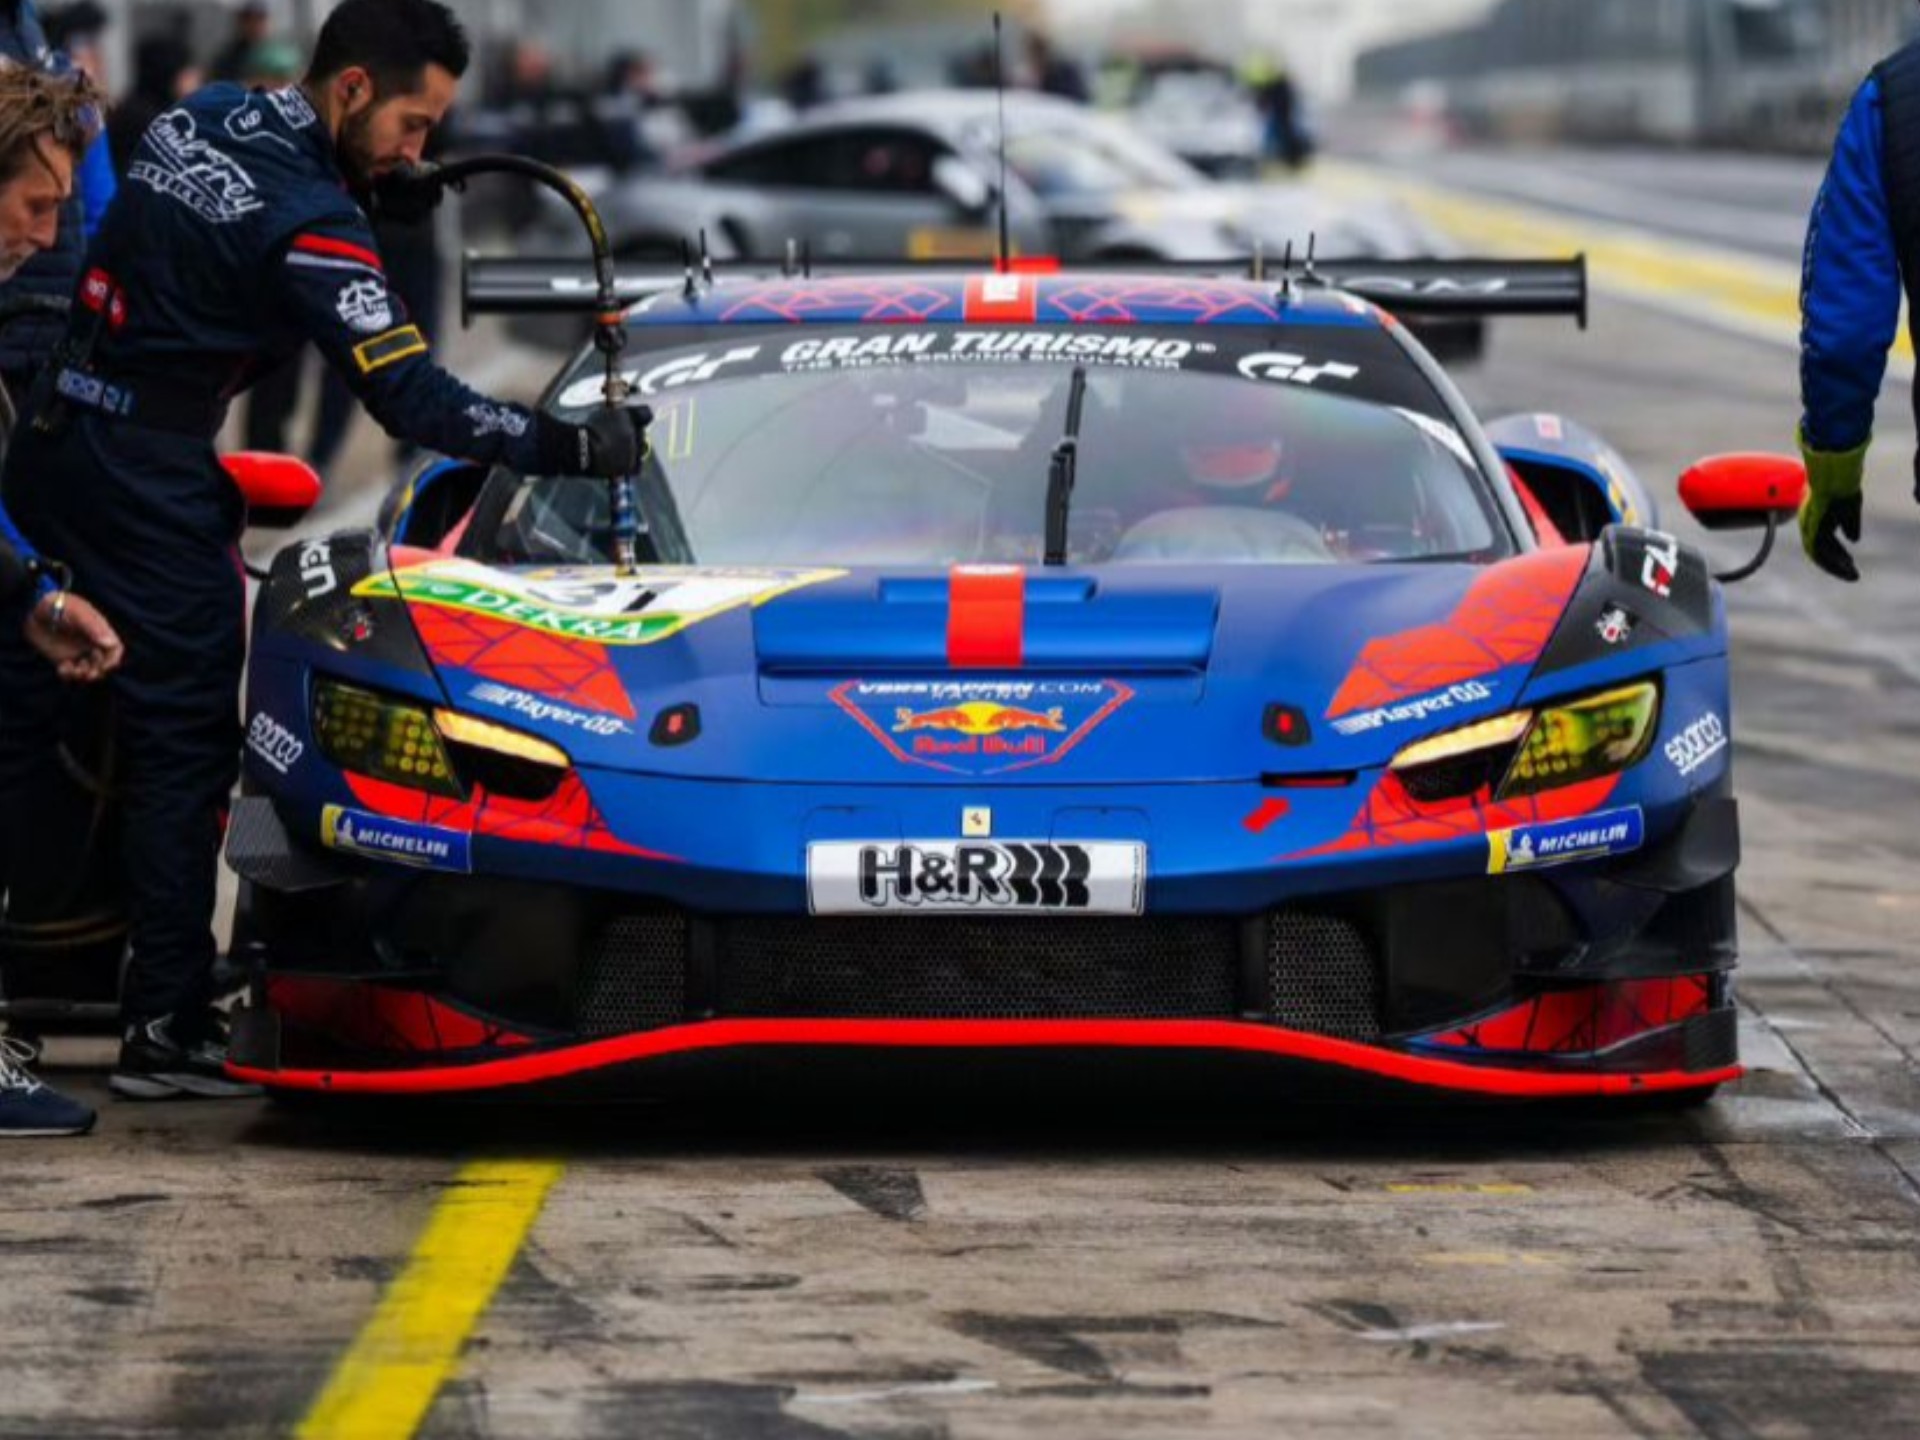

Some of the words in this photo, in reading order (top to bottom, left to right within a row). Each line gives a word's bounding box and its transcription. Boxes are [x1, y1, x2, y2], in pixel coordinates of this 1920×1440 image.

[780, 333, 938, 363] GRAN
[461, 590, 643, 640] DEKRA
[357, 830, 450, 858] MICHELIN
[1538, 820, 1629, 853] MICHELIN
